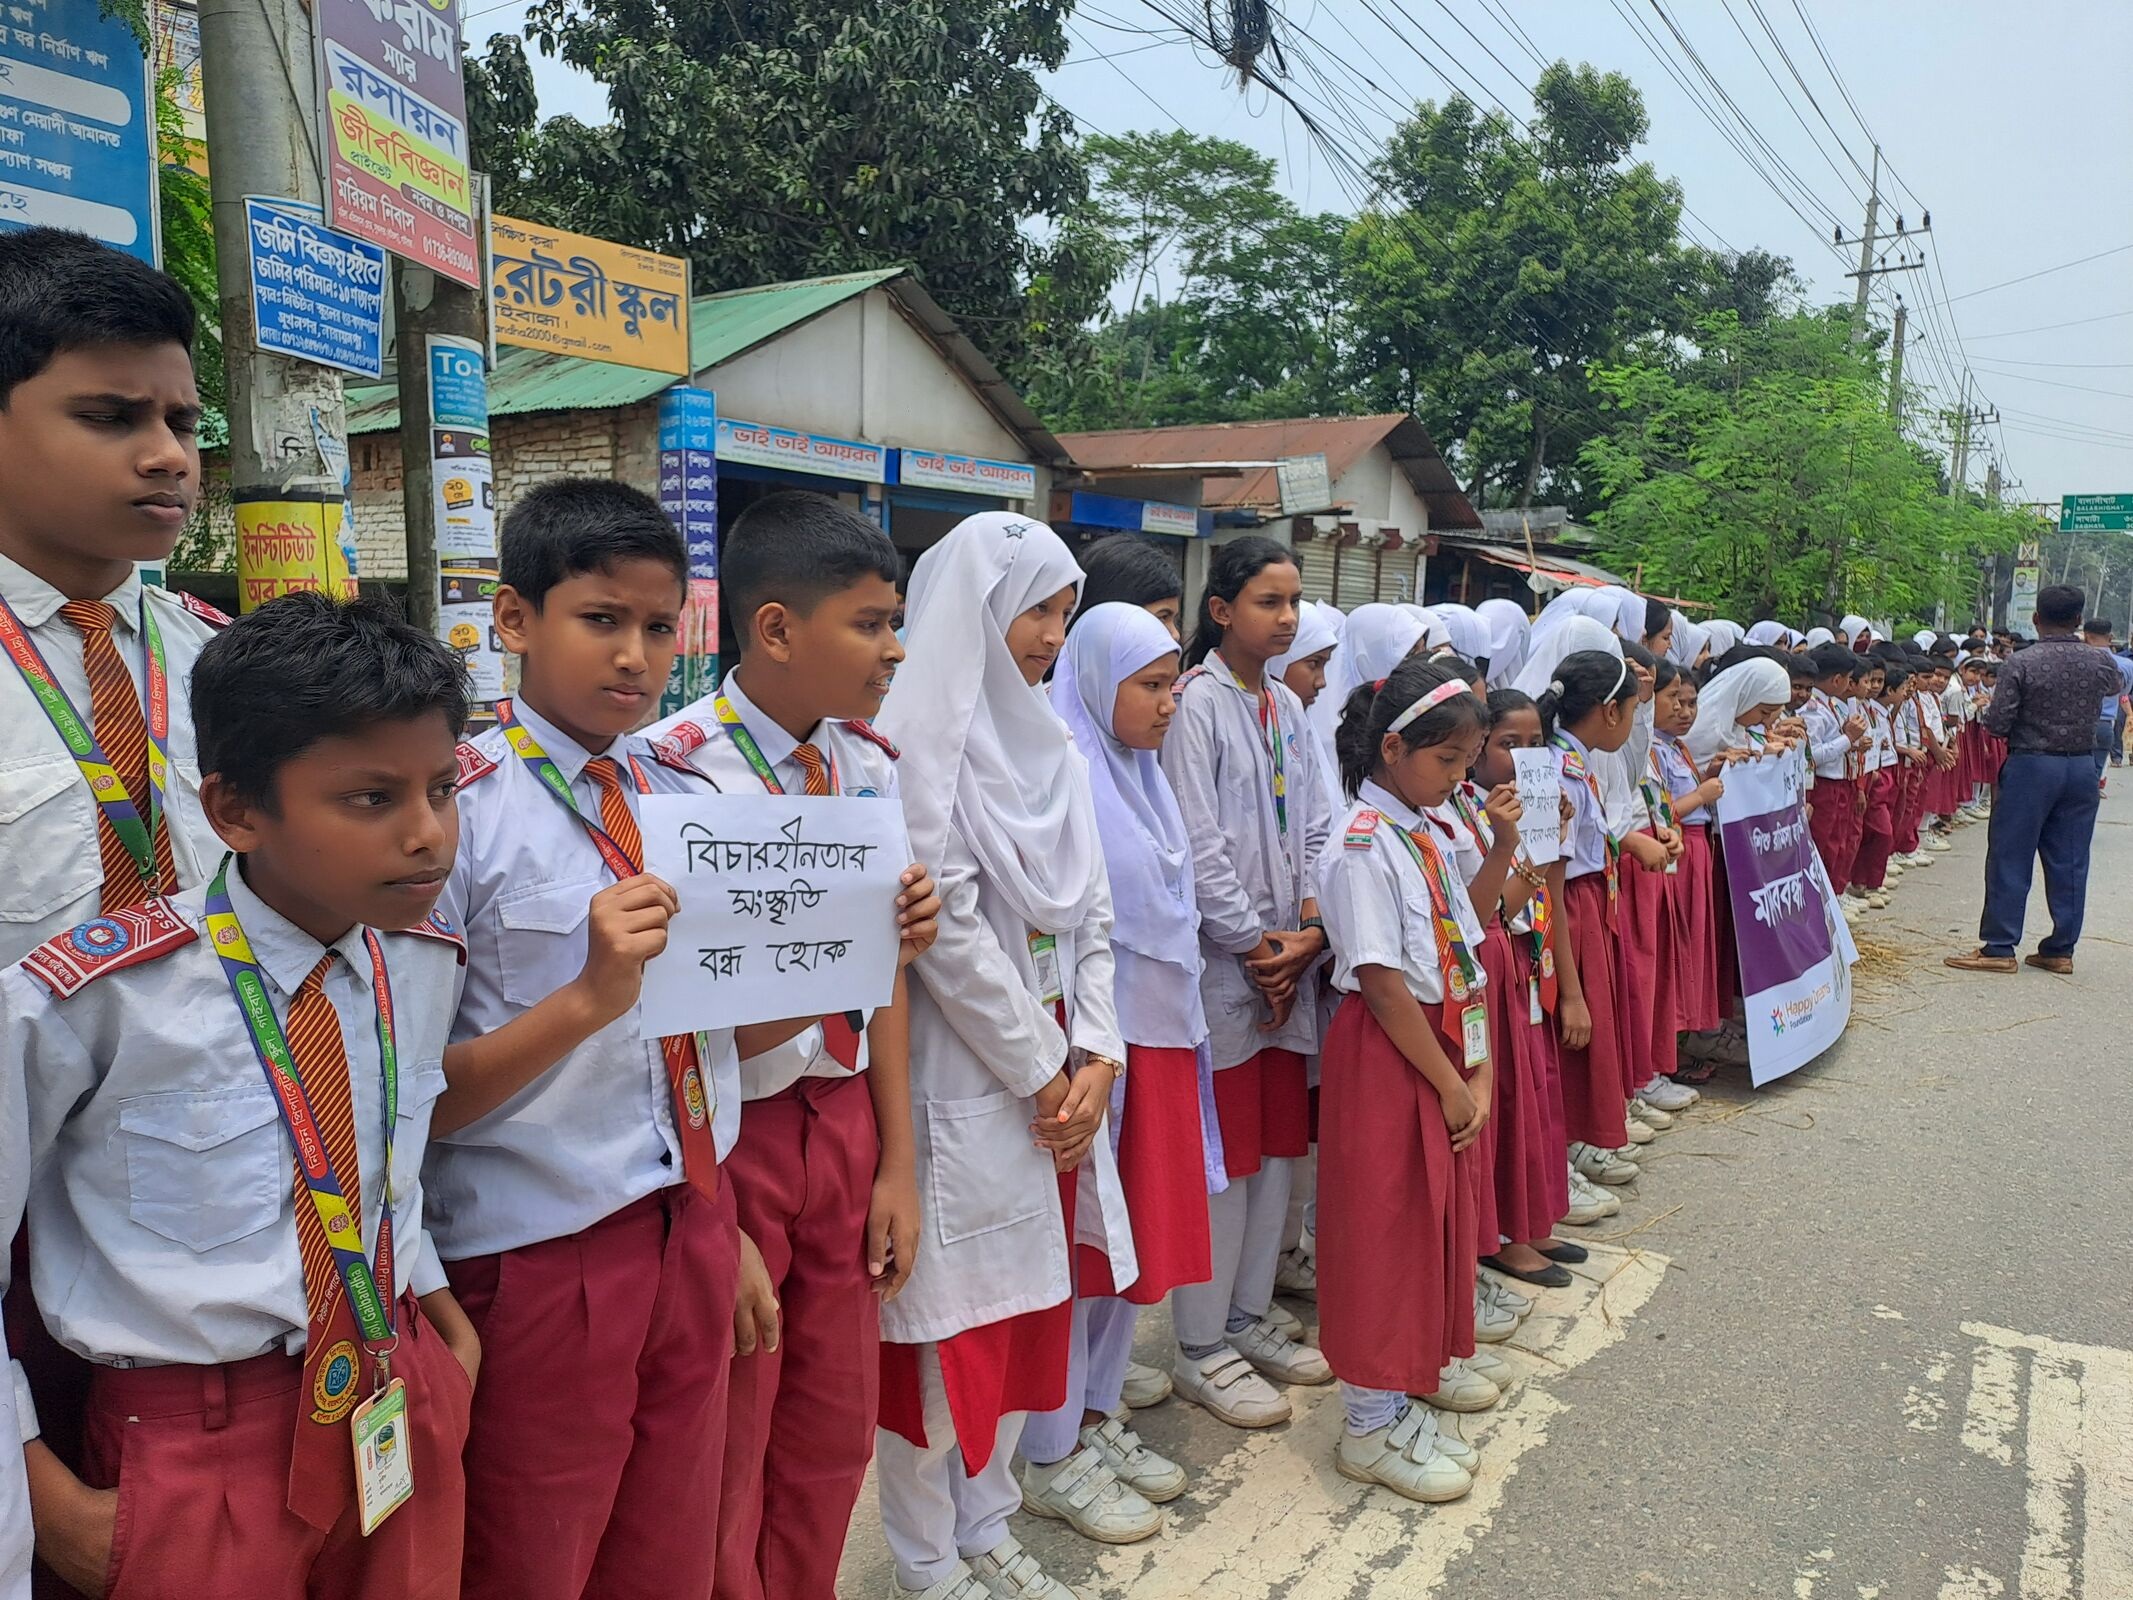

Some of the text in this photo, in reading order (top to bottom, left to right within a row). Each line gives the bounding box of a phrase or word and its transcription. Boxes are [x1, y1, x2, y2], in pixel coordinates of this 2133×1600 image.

[332, 50, 461, 153] রসায়ন
[335, 104, 464, 203] জীববিজ্ঞান
[380, 193, 416, 235] নিবাস
[252, 216, 297, 258] জমি
[297, 225, 346, 278] বিক্রয়
[256, 254, 293, 285] জমির
[611, 279, 683, 344] স্কুল
[733, 427, 878, 463] ভাই ভাই আয়রন
[916, 455, 1032, 483] ভাই ভাই আয়রন
[242, 521, 317, 573] ইনস্টিটিউট
[58, 708, 88, 749] গাইবান্ধা
[680, 816, 878, 873] বিচারহীনতার
[727, 878, 828, 925] সংস্কৃতি
[698, 939, 853, 981] বন্ধ হোক
[243, 981, 267, 1029] গাইবান্ধা
[1785, 994, 1814, 1018] Happy
[273, 1063, 304, 1125] প্রিপারেটরী
[299, 1129, 321, 1169] নিউটন
[380, 1226, 389, 1265] Newton
[351, 1268, 376, 1321] Gaibandha
